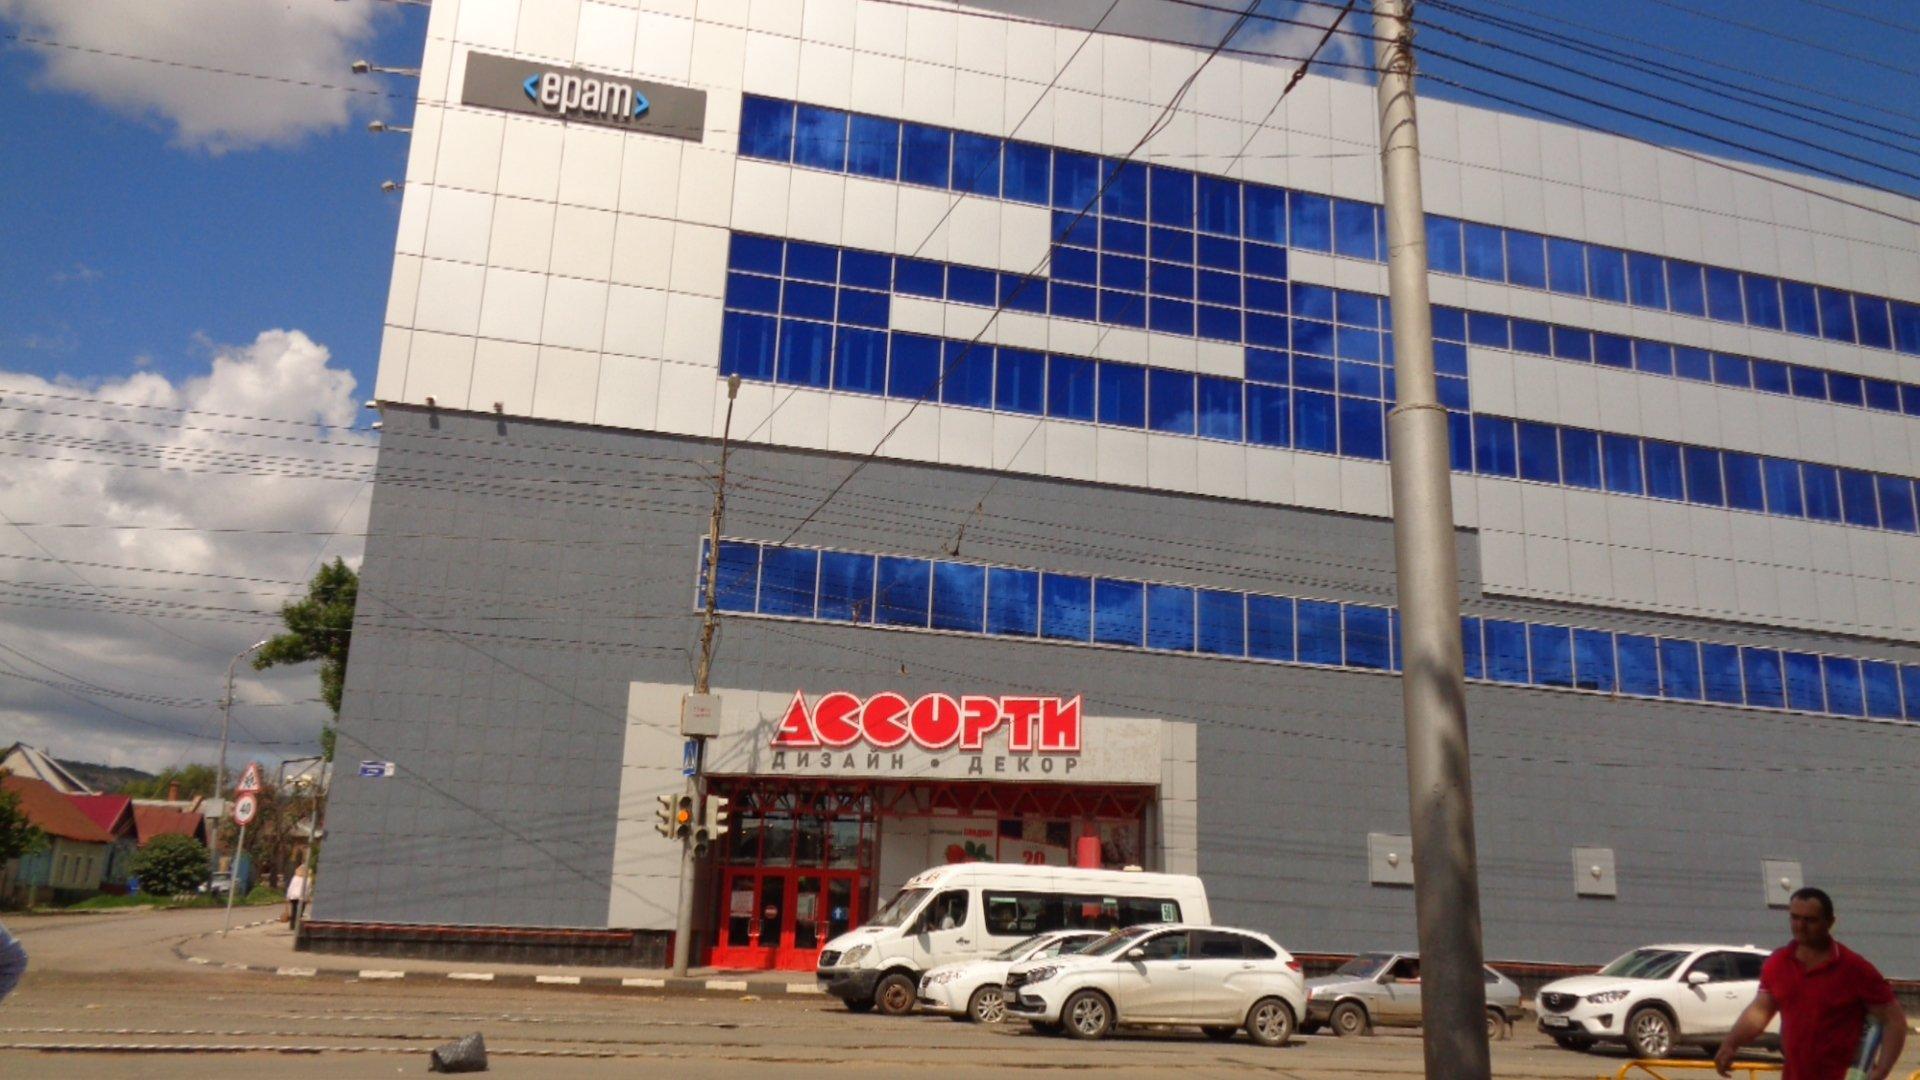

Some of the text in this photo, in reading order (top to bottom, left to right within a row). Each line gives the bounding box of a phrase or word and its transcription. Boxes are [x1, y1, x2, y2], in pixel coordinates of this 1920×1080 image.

[770, 689, 1082, 751] АССОРТИ
[771, 750, 1078, 775] ДИЗАЙН ДЕКОР
[240, 802, 252, 815] 40
